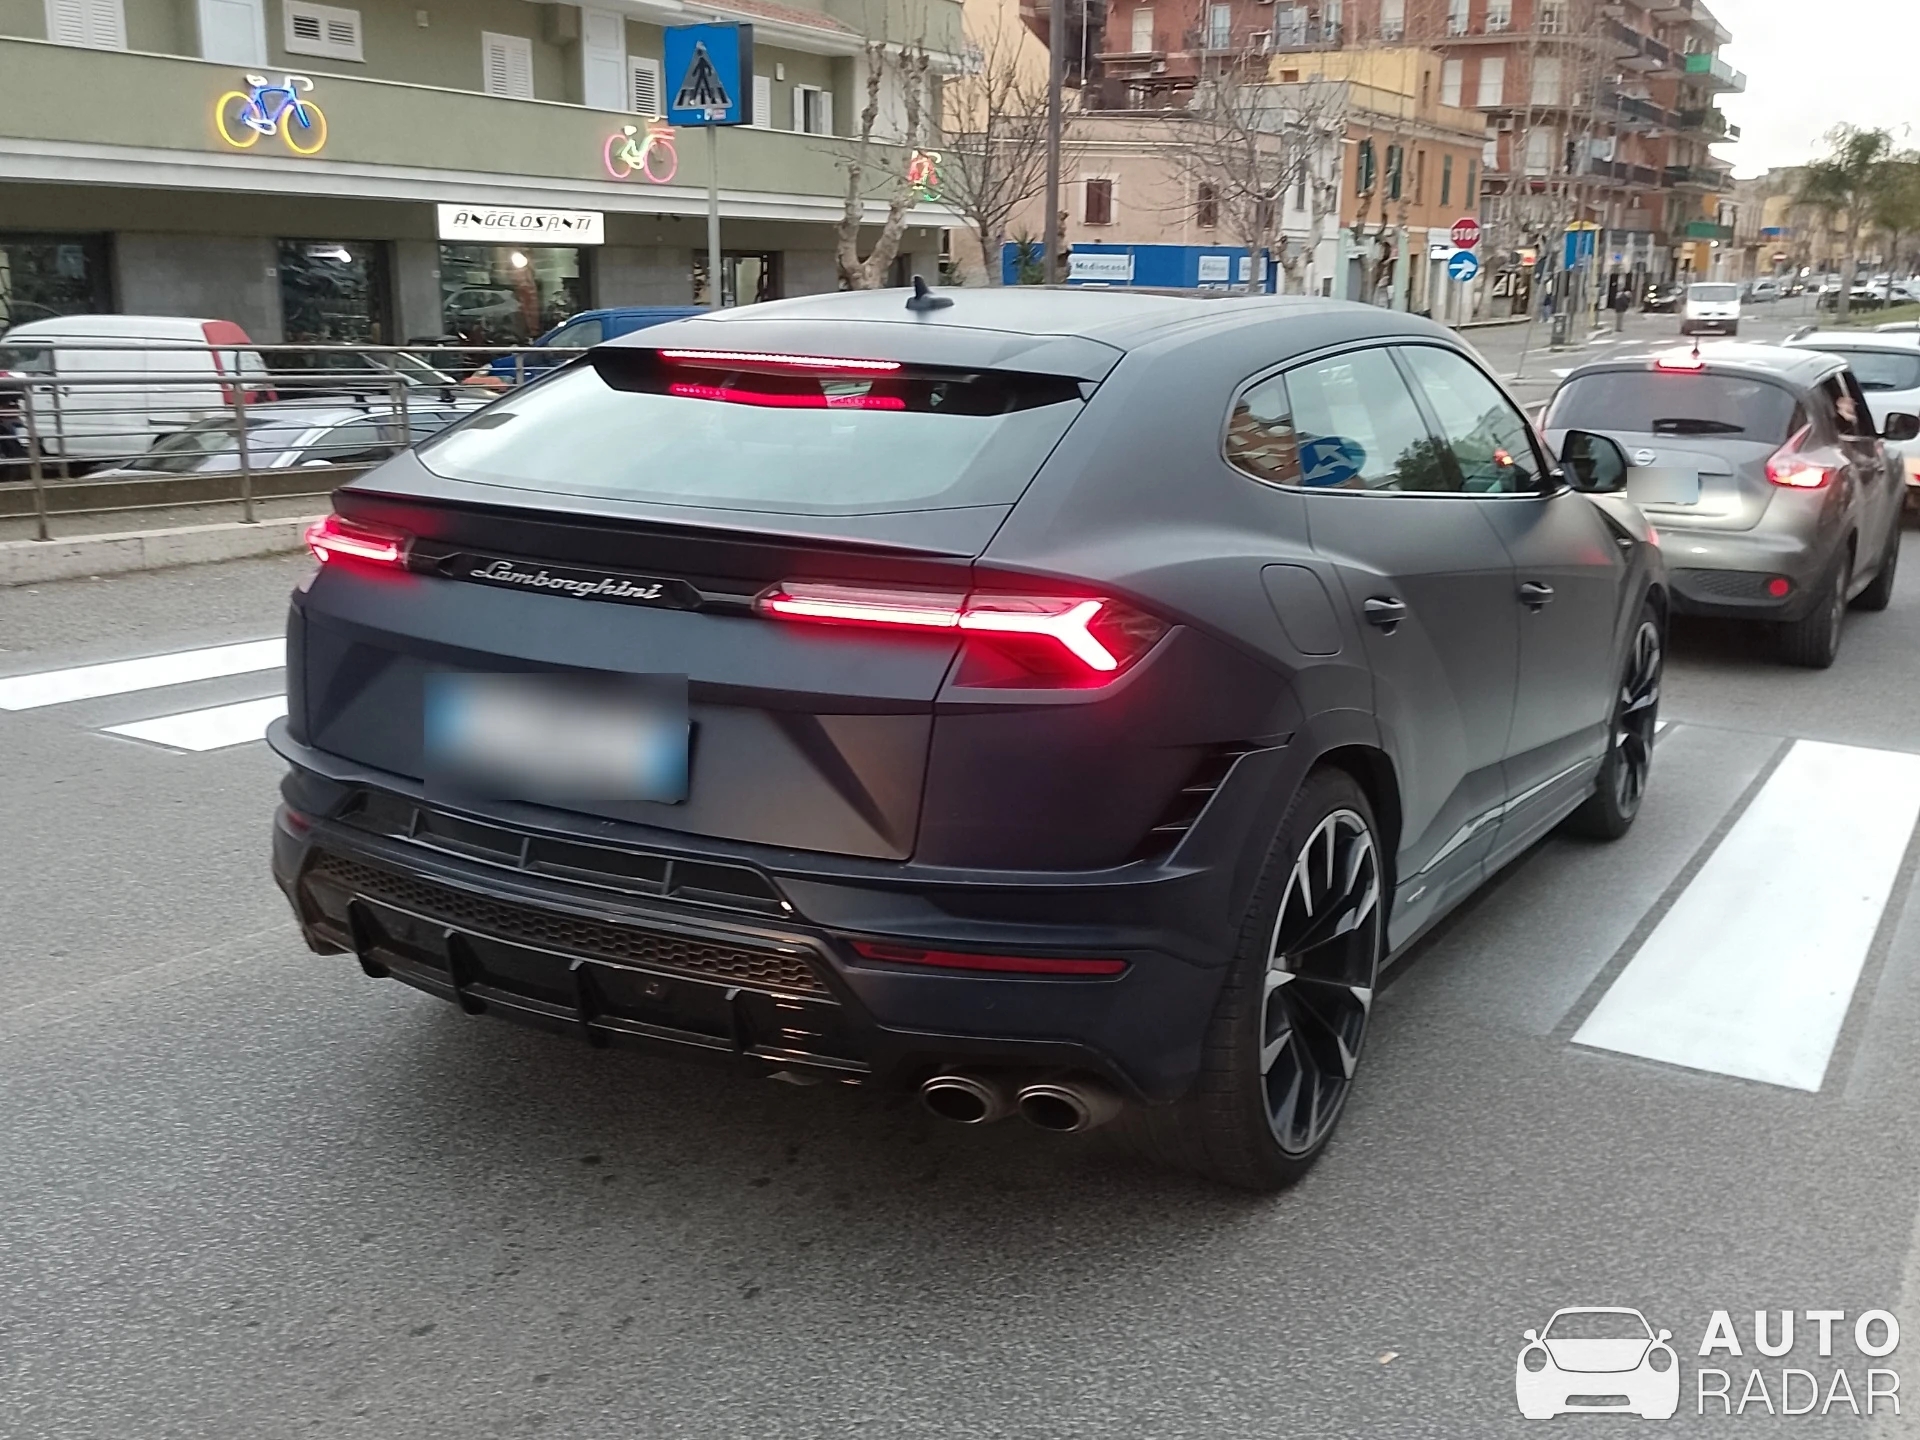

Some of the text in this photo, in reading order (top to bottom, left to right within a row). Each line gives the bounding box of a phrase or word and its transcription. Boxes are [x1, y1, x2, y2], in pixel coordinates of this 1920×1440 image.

[453, 212, 592, 232] ANGELOSANTI
[1452, 227, 1480, 241] STOP
[470, 560, 664, 599] Lamborghini
